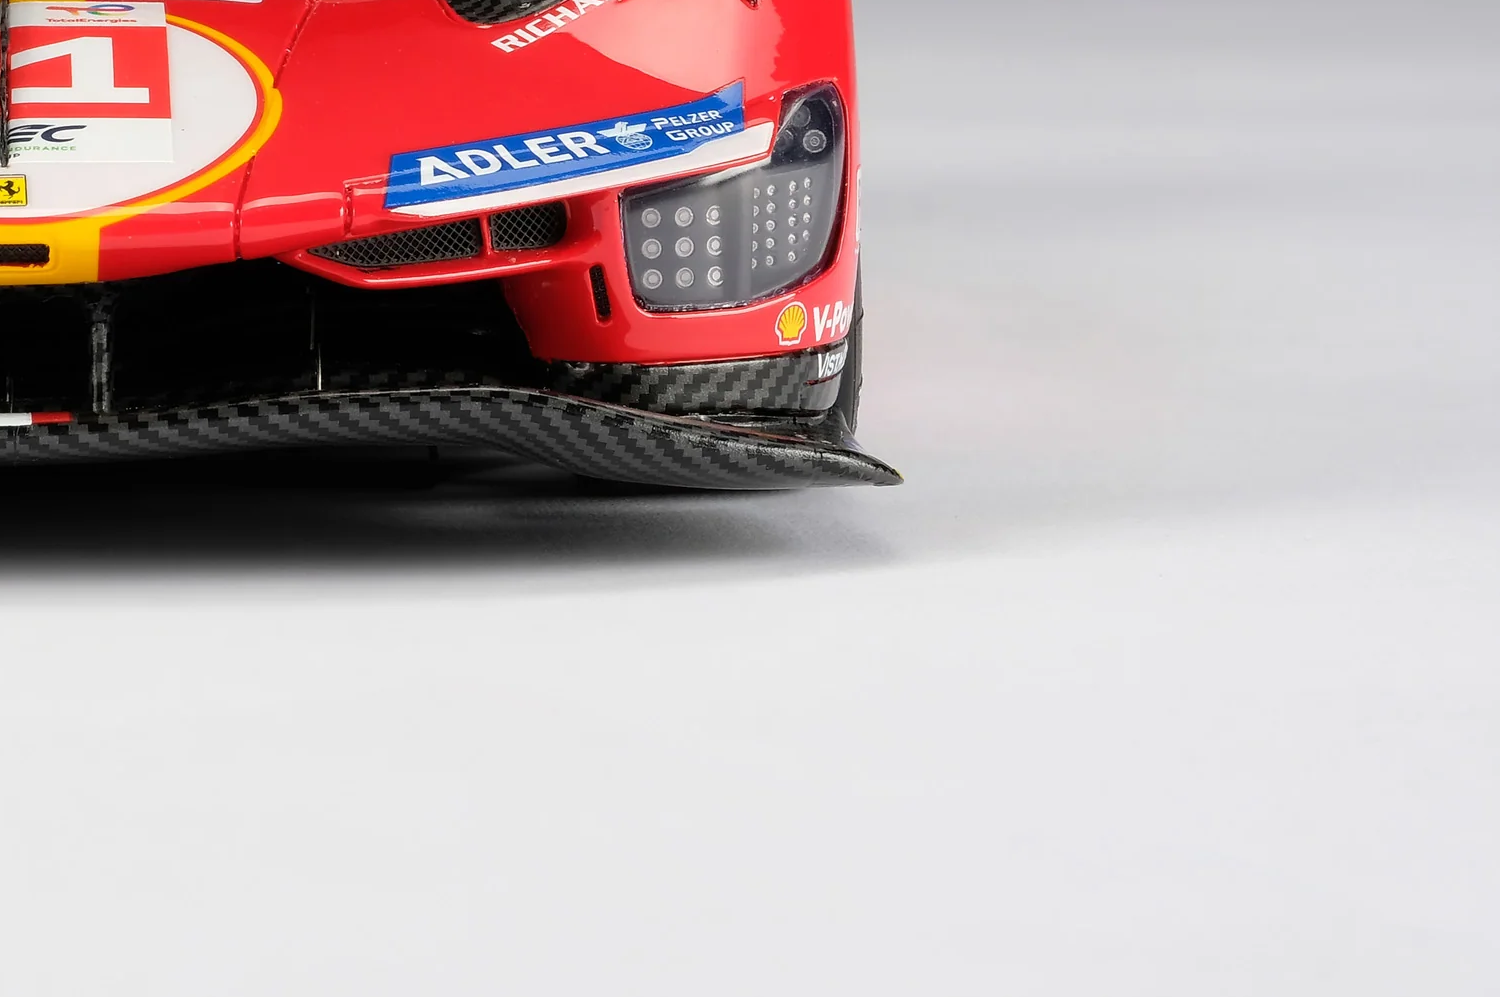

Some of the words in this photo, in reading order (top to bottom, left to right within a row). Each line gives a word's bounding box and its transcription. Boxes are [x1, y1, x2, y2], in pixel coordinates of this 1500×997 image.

[651, 109, 724, 131] PELZER
[665, 120, 736, 143] GROUP
[418, 130, 612, 187] ADLER
